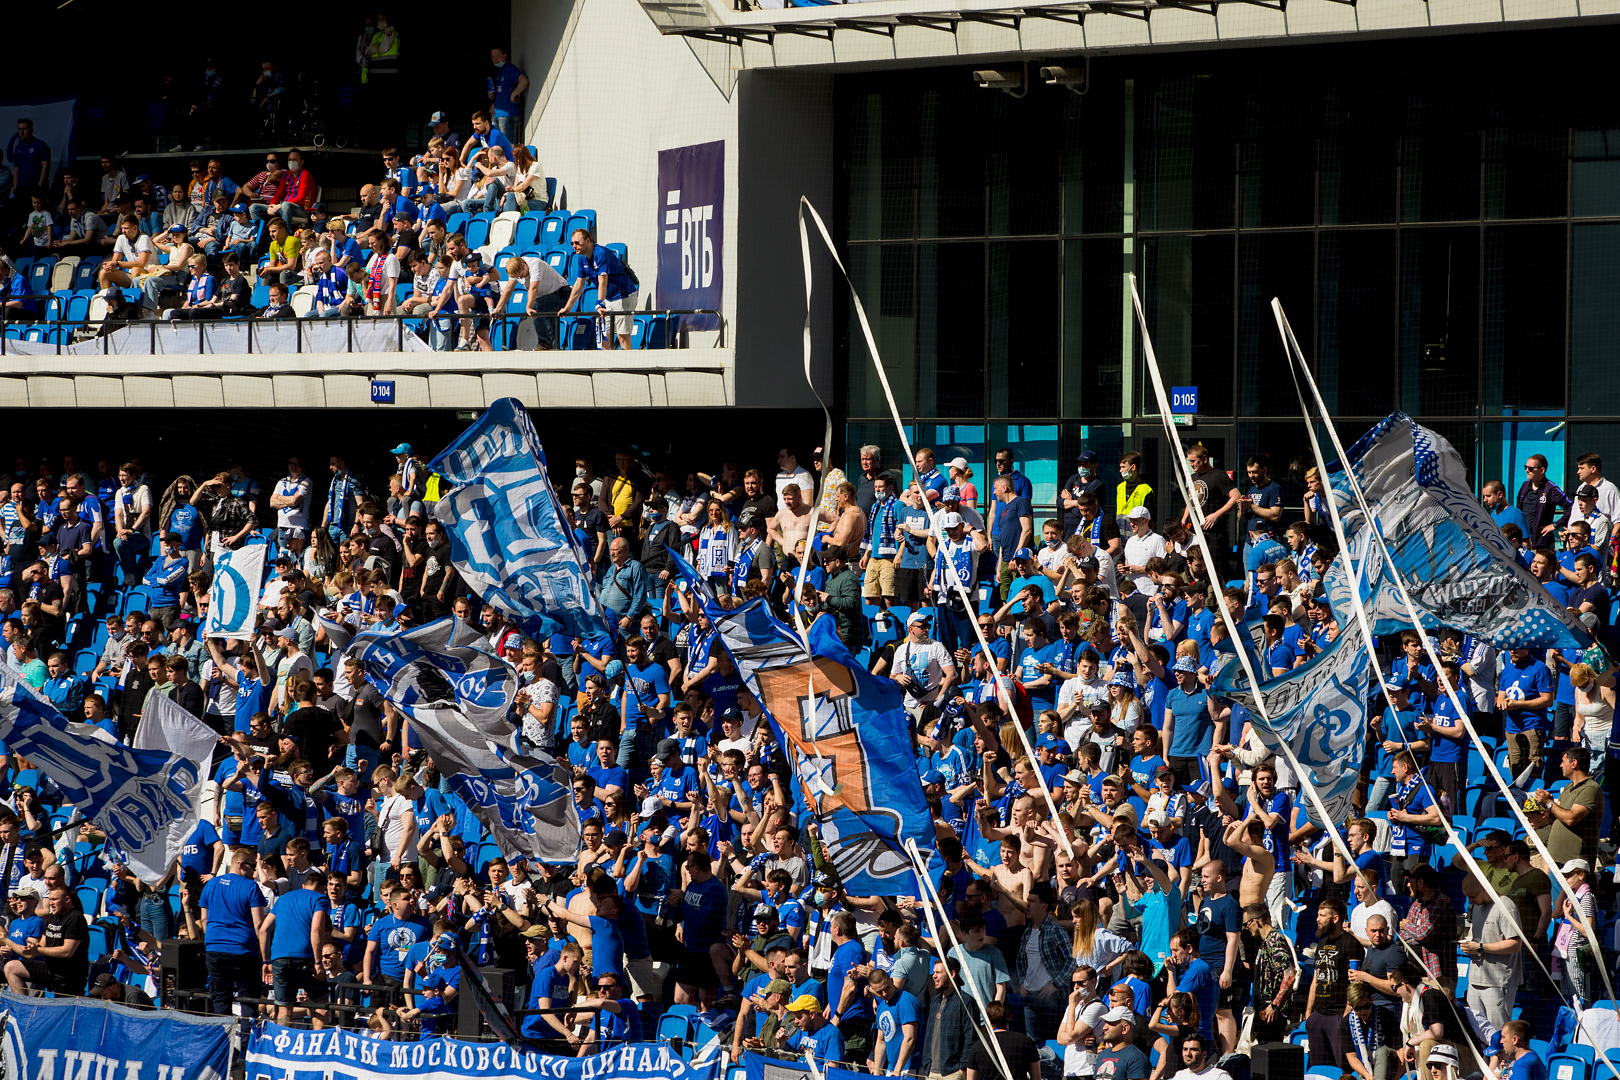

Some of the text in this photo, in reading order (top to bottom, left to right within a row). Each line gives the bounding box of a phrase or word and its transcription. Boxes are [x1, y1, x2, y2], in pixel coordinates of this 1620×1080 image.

[681, 204, 714, 290] ВТБ
[373, 385, 391, 397] D 104
[1174, 393, 1196, 406] D 105
[664, 790, 678, 799] ВТБ
[183, 844, 198, 855] ВТБ
[274, 1029, 380, 1066] ФАНАТЫ
[389, 1040, 569, 1079] МОСКОВСКОГО
